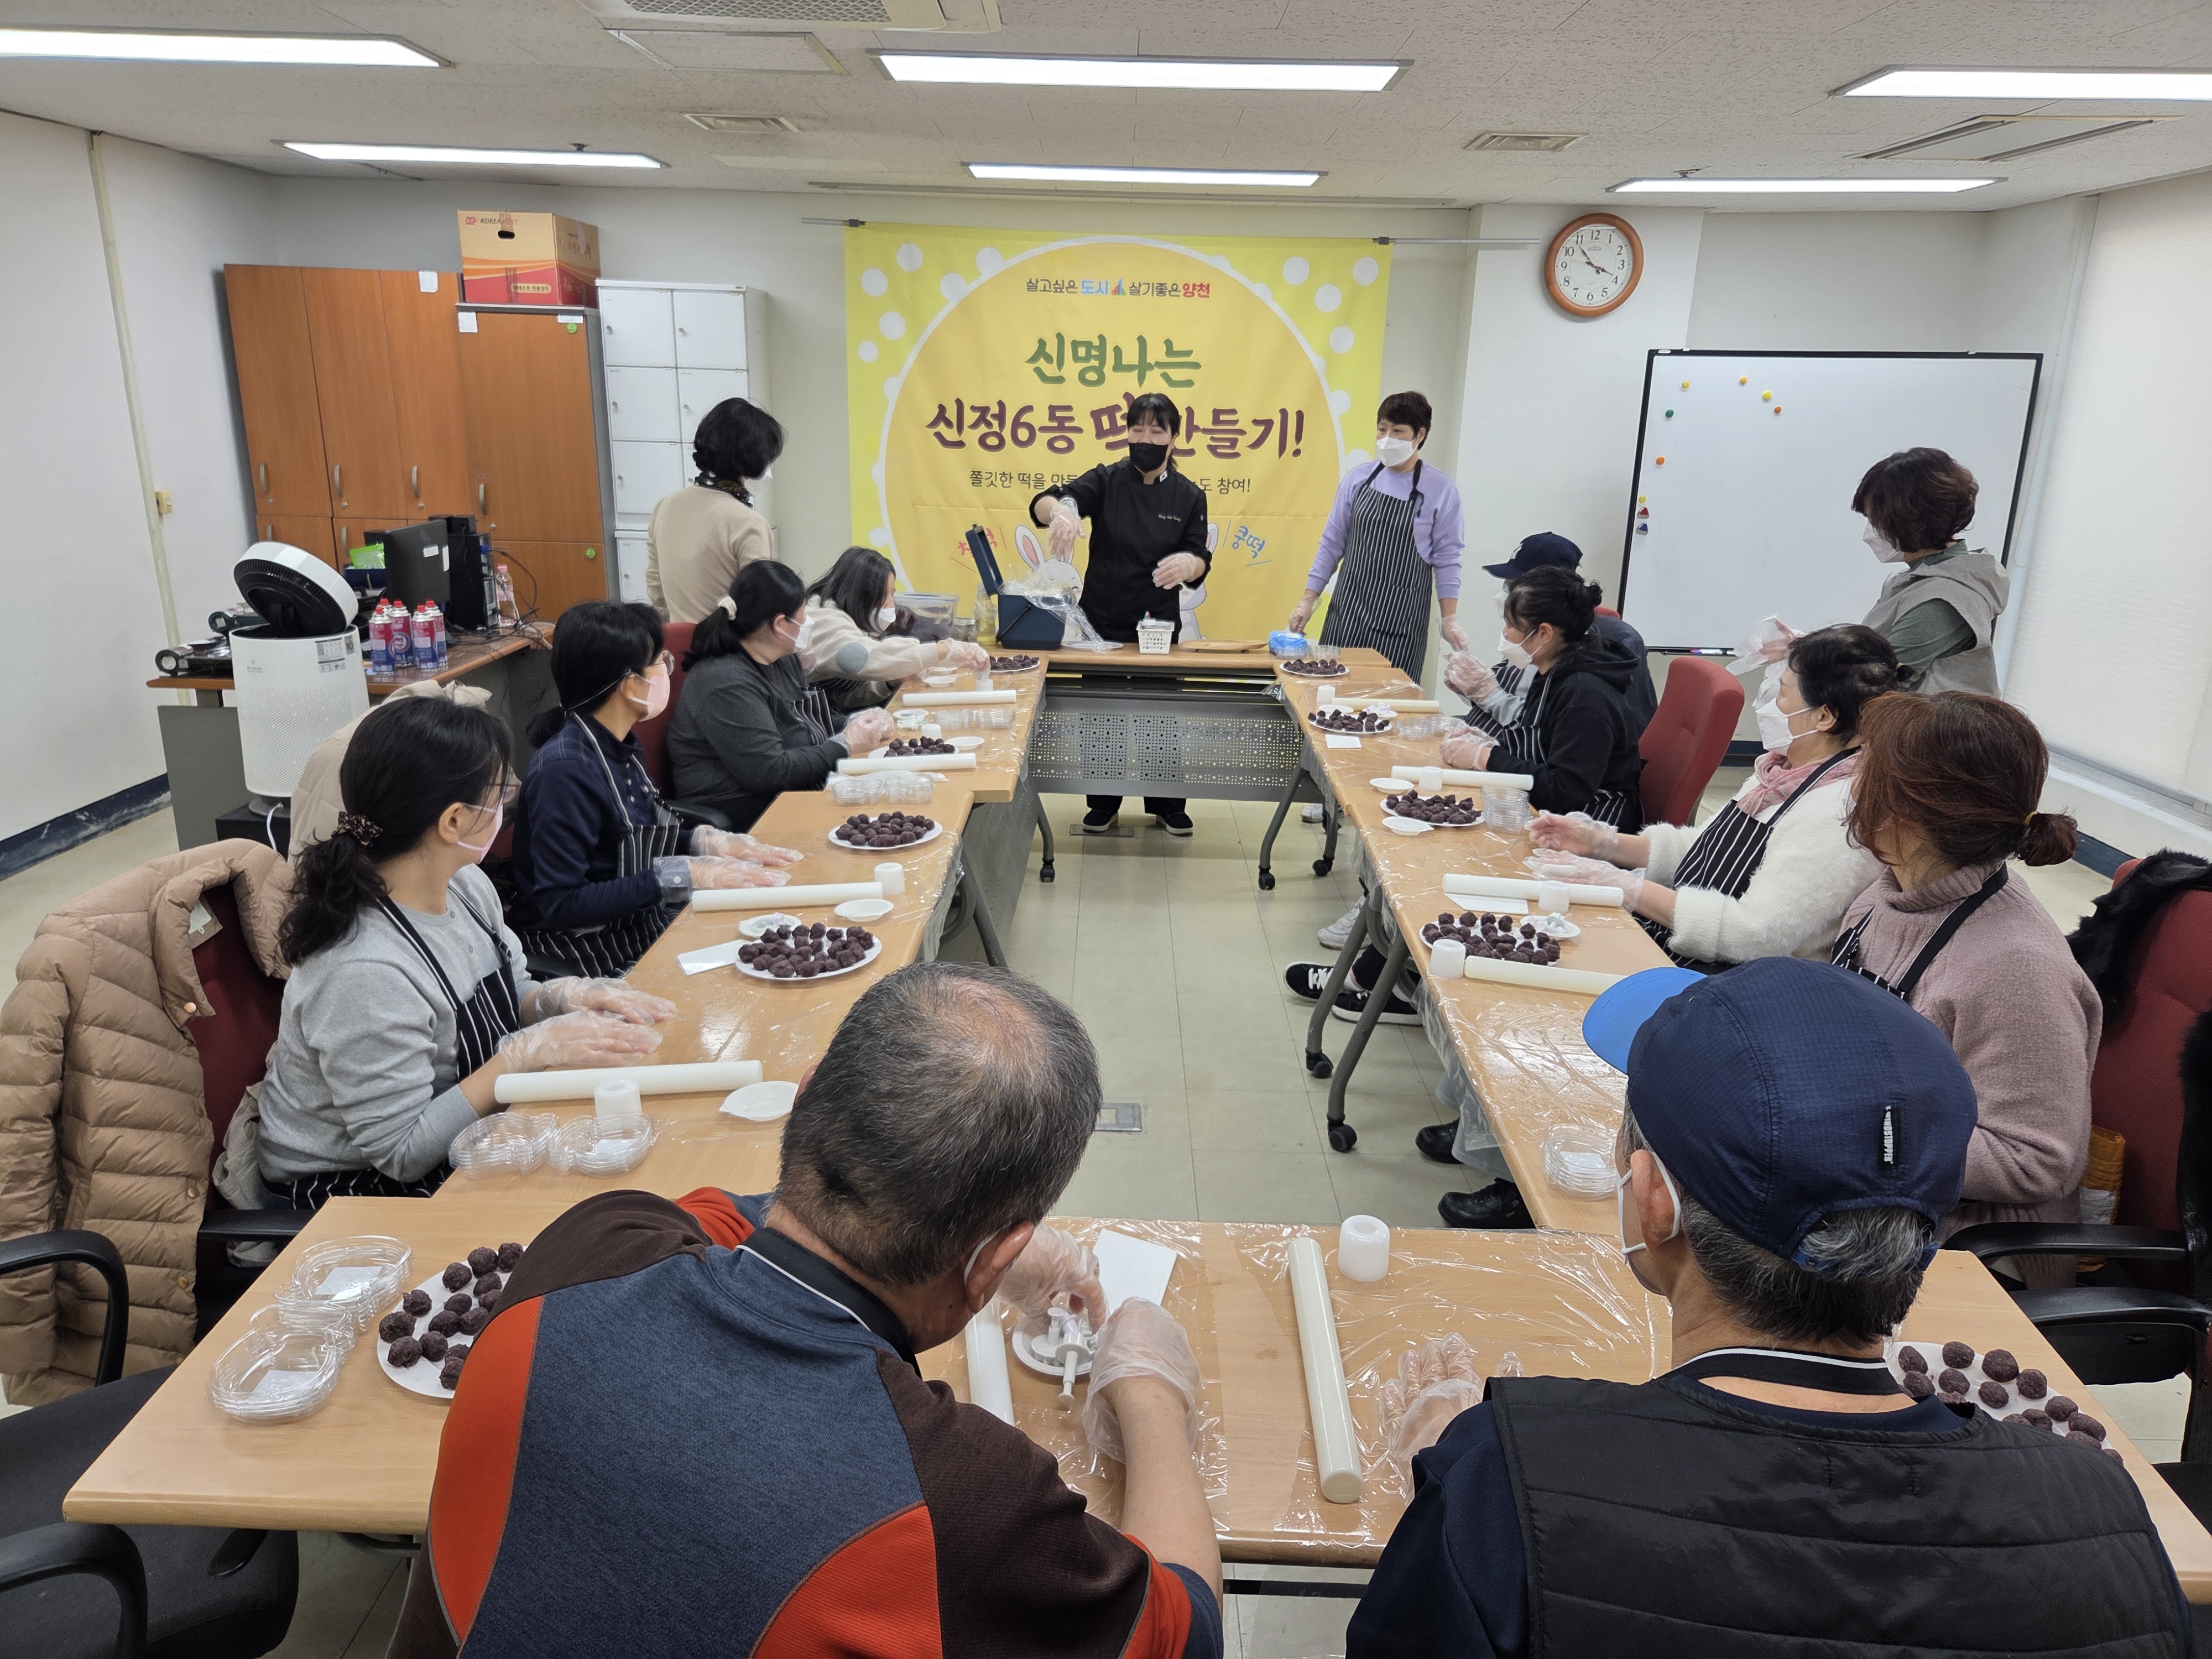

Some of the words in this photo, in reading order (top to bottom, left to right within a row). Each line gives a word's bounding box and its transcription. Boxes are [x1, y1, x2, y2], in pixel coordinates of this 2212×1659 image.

[1576, 234, 1583, 244] 11
[1591, 230, 1600, 240] 12
[1609, 234, 1612, 244] 1
[1564, 246, 1574, 257] 10
[1616, 246, 1623, 255] 2
[1561, 261, 1567, 270] 9
[1618, 259, 1625, 270] 3
[1563, 276, 1570, 286] 8
[1611, 275, 1618, 285] 4
[1026, 278, 1078, 294] 살고싶은
[1081, 279, 1109, 295] 도시
[1573, 288, 1579, 298] 7
[1587, 291, 1594, 301] 6
[1601, 288, 1608, 297] 5
[1024, 332, 1202, 389] 신명나는
[925, 398, 1084, 455] 신정6동
[969, 470, 1014, 488] 쫄깃한
[1018, 472, 1046, 489] 떡을
[1217, 477, 1251, 494] 참여!
[1232, 525, 1265, 559] 쿵떡
